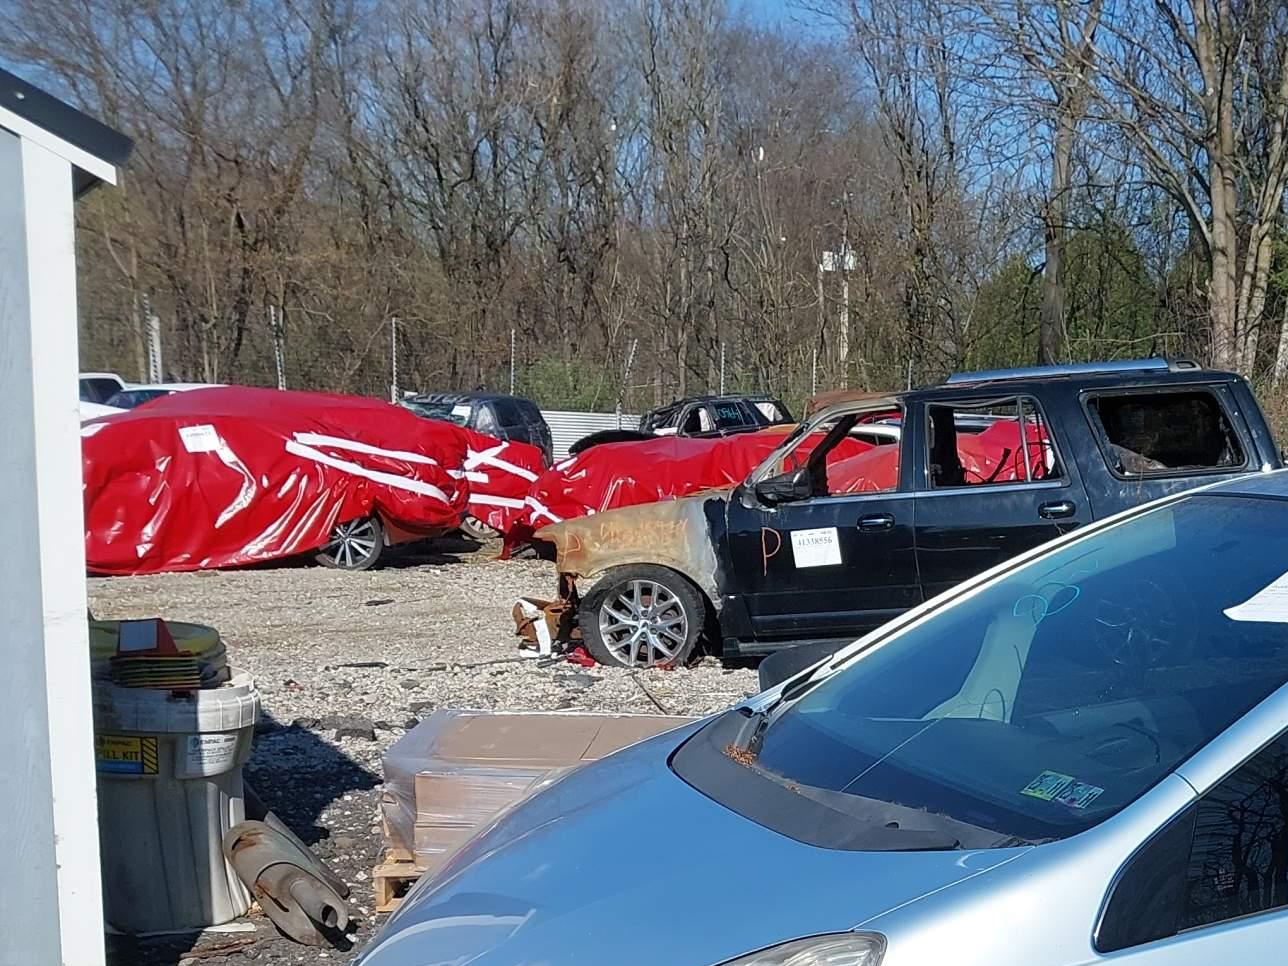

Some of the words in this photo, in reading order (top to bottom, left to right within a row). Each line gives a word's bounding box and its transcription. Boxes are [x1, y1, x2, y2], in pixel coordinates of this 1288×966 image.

[796, 535, 833, 547] 41338556
[761, 527, 781, 576] P
[122, 751, 140, 760] KIT
